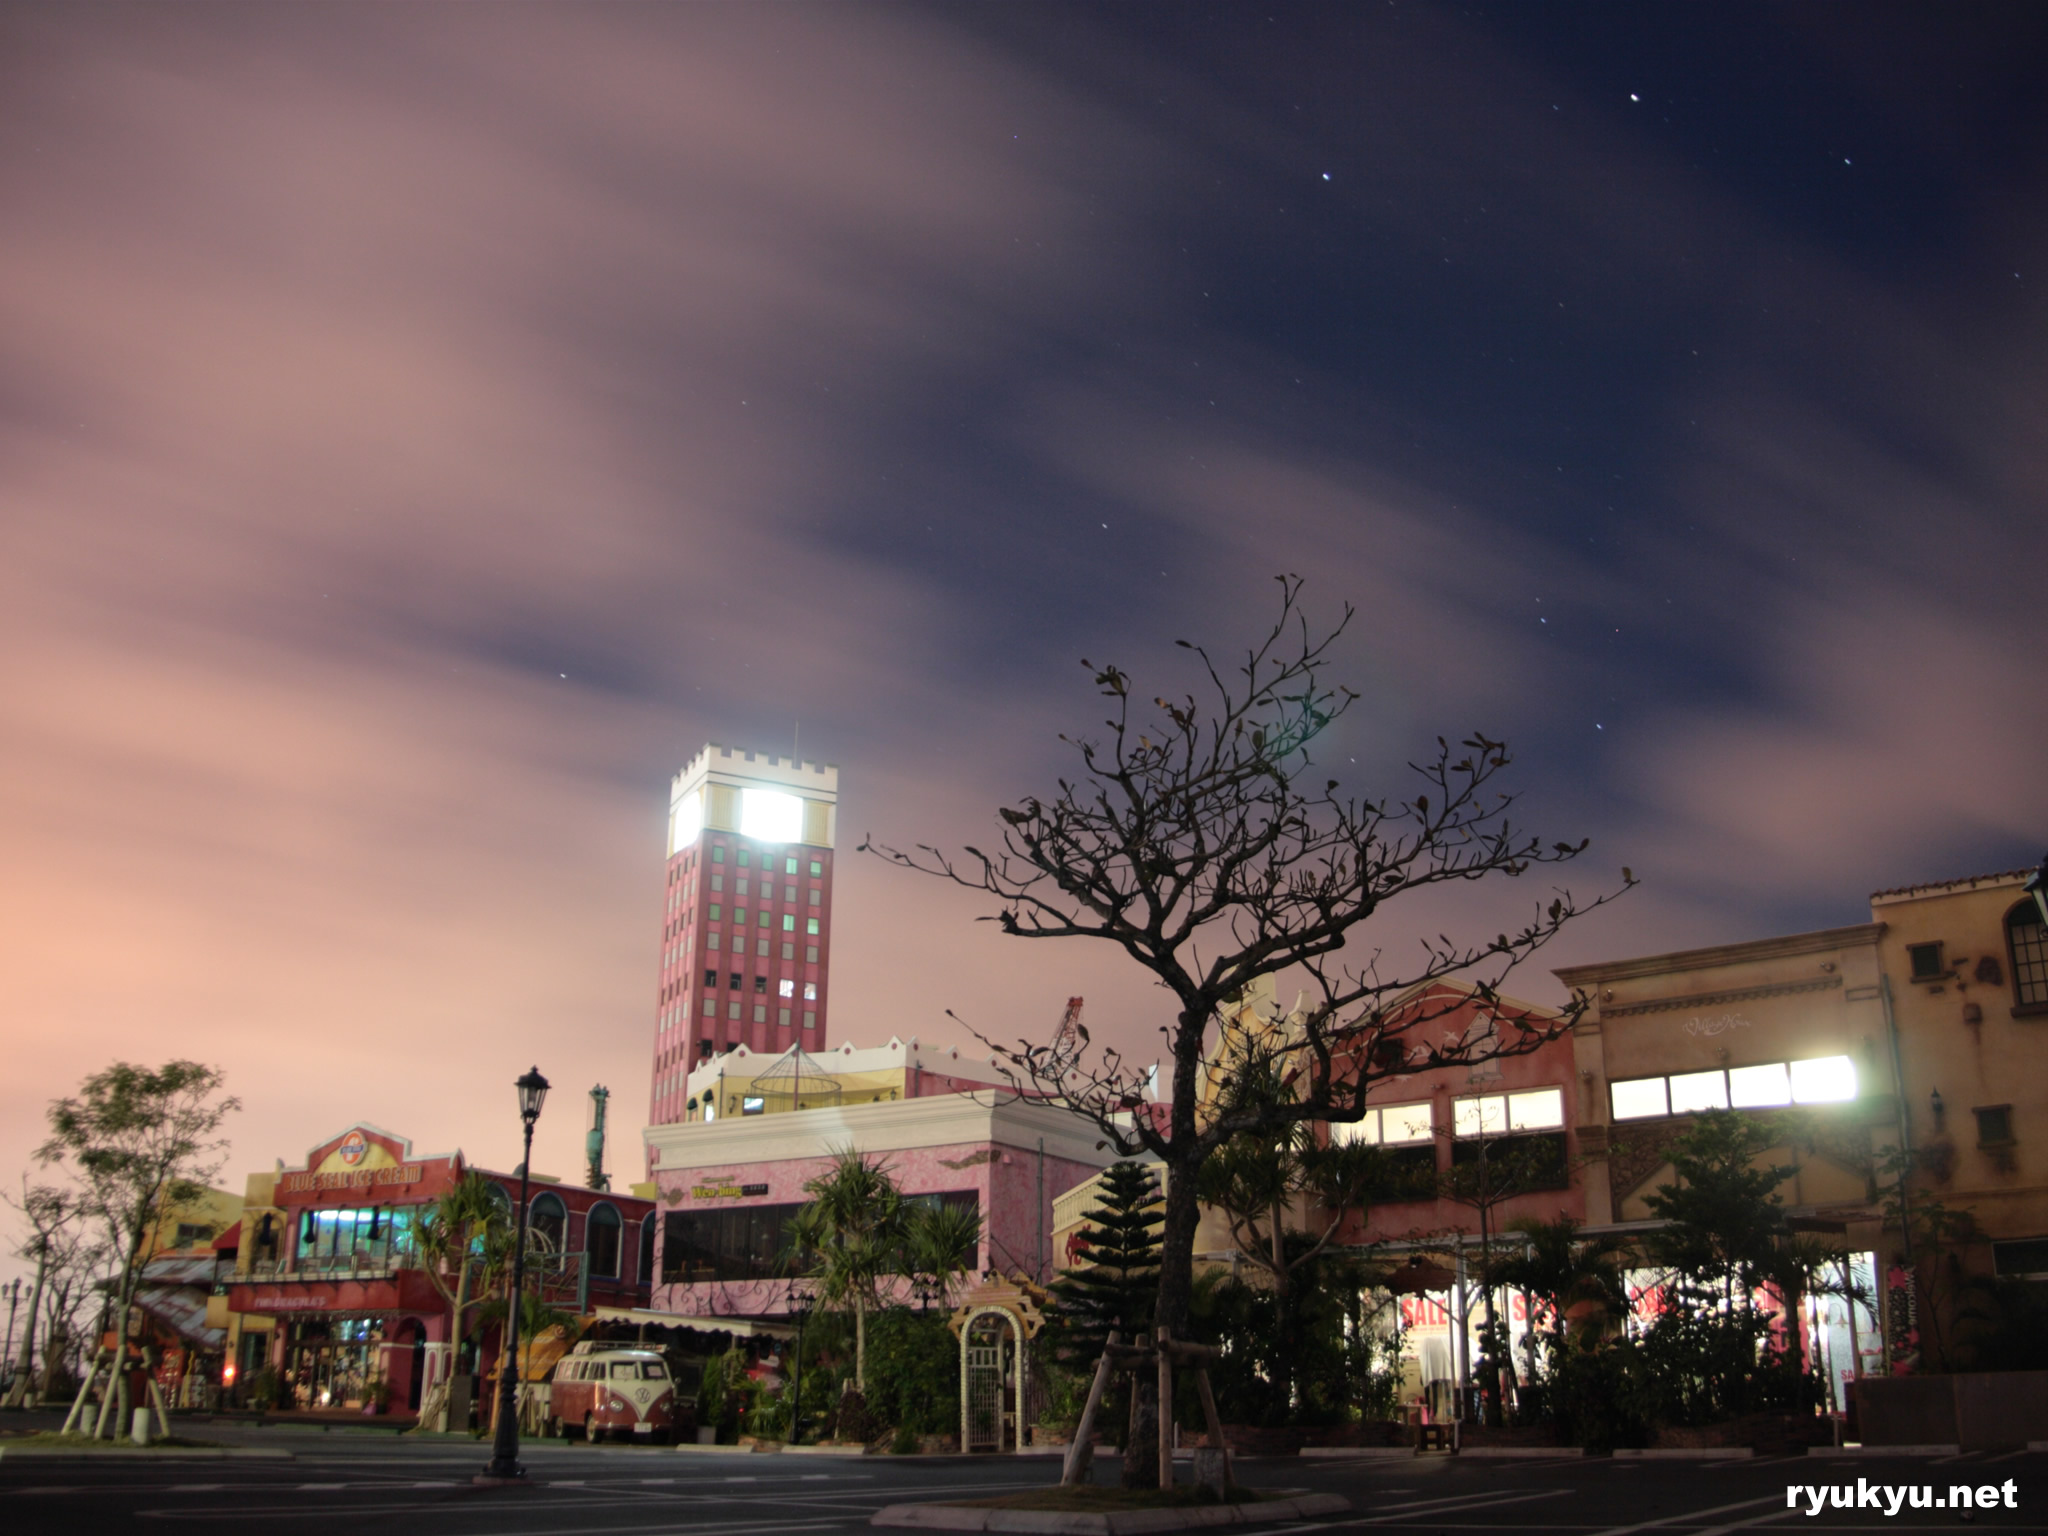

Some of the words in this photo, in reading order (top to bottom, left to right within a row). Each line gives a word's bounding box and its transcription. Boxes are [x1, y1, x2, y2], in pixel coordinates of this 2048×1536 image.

[284, 1173, 316, 1192] BLUE
[317, 1171, 349, 1190] SEAL
[350, 1168, 371, 1187] ICE
[375, 1165, 422, 1186] CREAM
[1402, 1298, 1447, 1327] SALE
